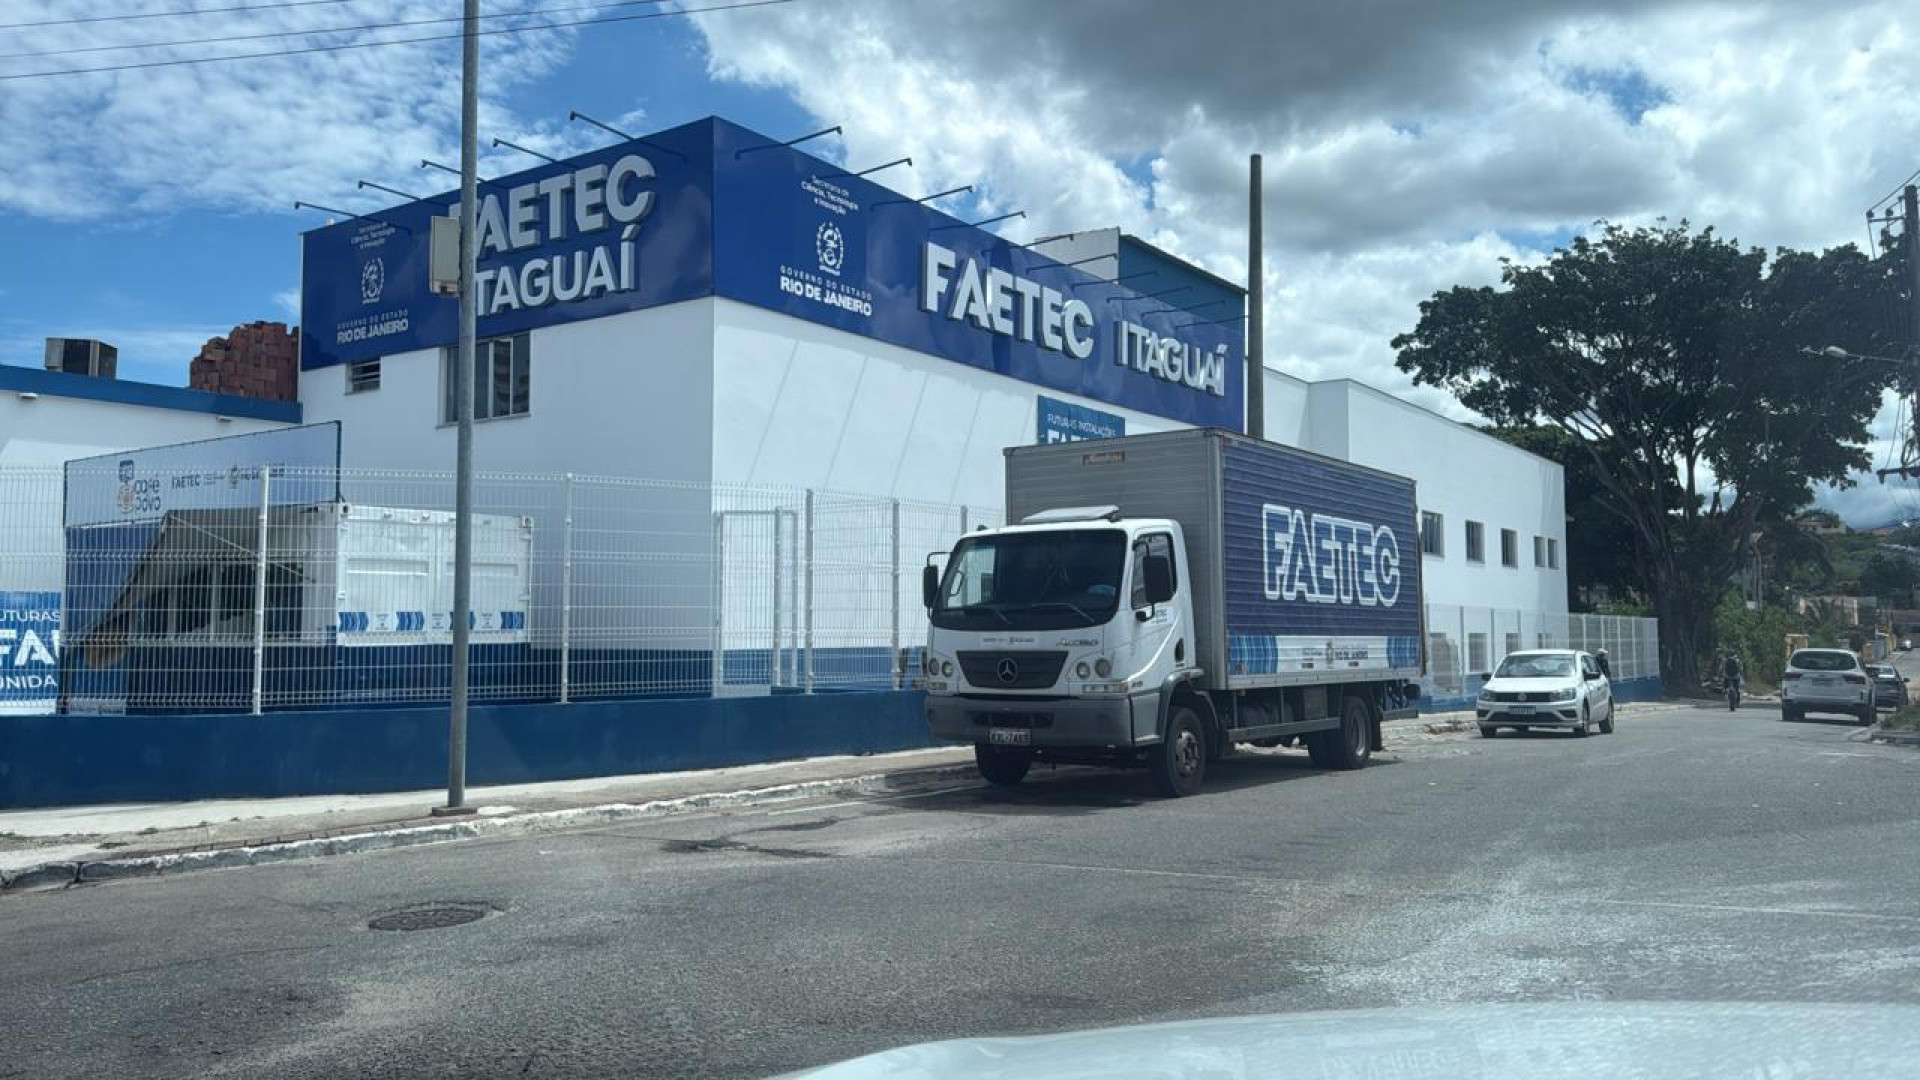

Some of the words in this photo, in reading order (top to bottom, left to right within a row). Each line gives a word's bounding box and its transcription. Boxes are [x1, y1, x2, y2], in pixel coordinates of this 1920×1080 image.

[449, 154, 656, 259] AETEC
[475, 224, 636, 316] TAGUAÍ
[780, 276, 804, 296] RIO
[805, 283, 822, 301] DE
[824, 290, 872, 317] JANEIRO
[368, 318, 409, 338] JANEIRO
[923, 241, 1095, 360] FAETEC
[1117, 320, 1226, 397] ITAGUAÍ
[1262, 502, 1401, 608] FAETEC
[0, 629, 60, 666] FA
